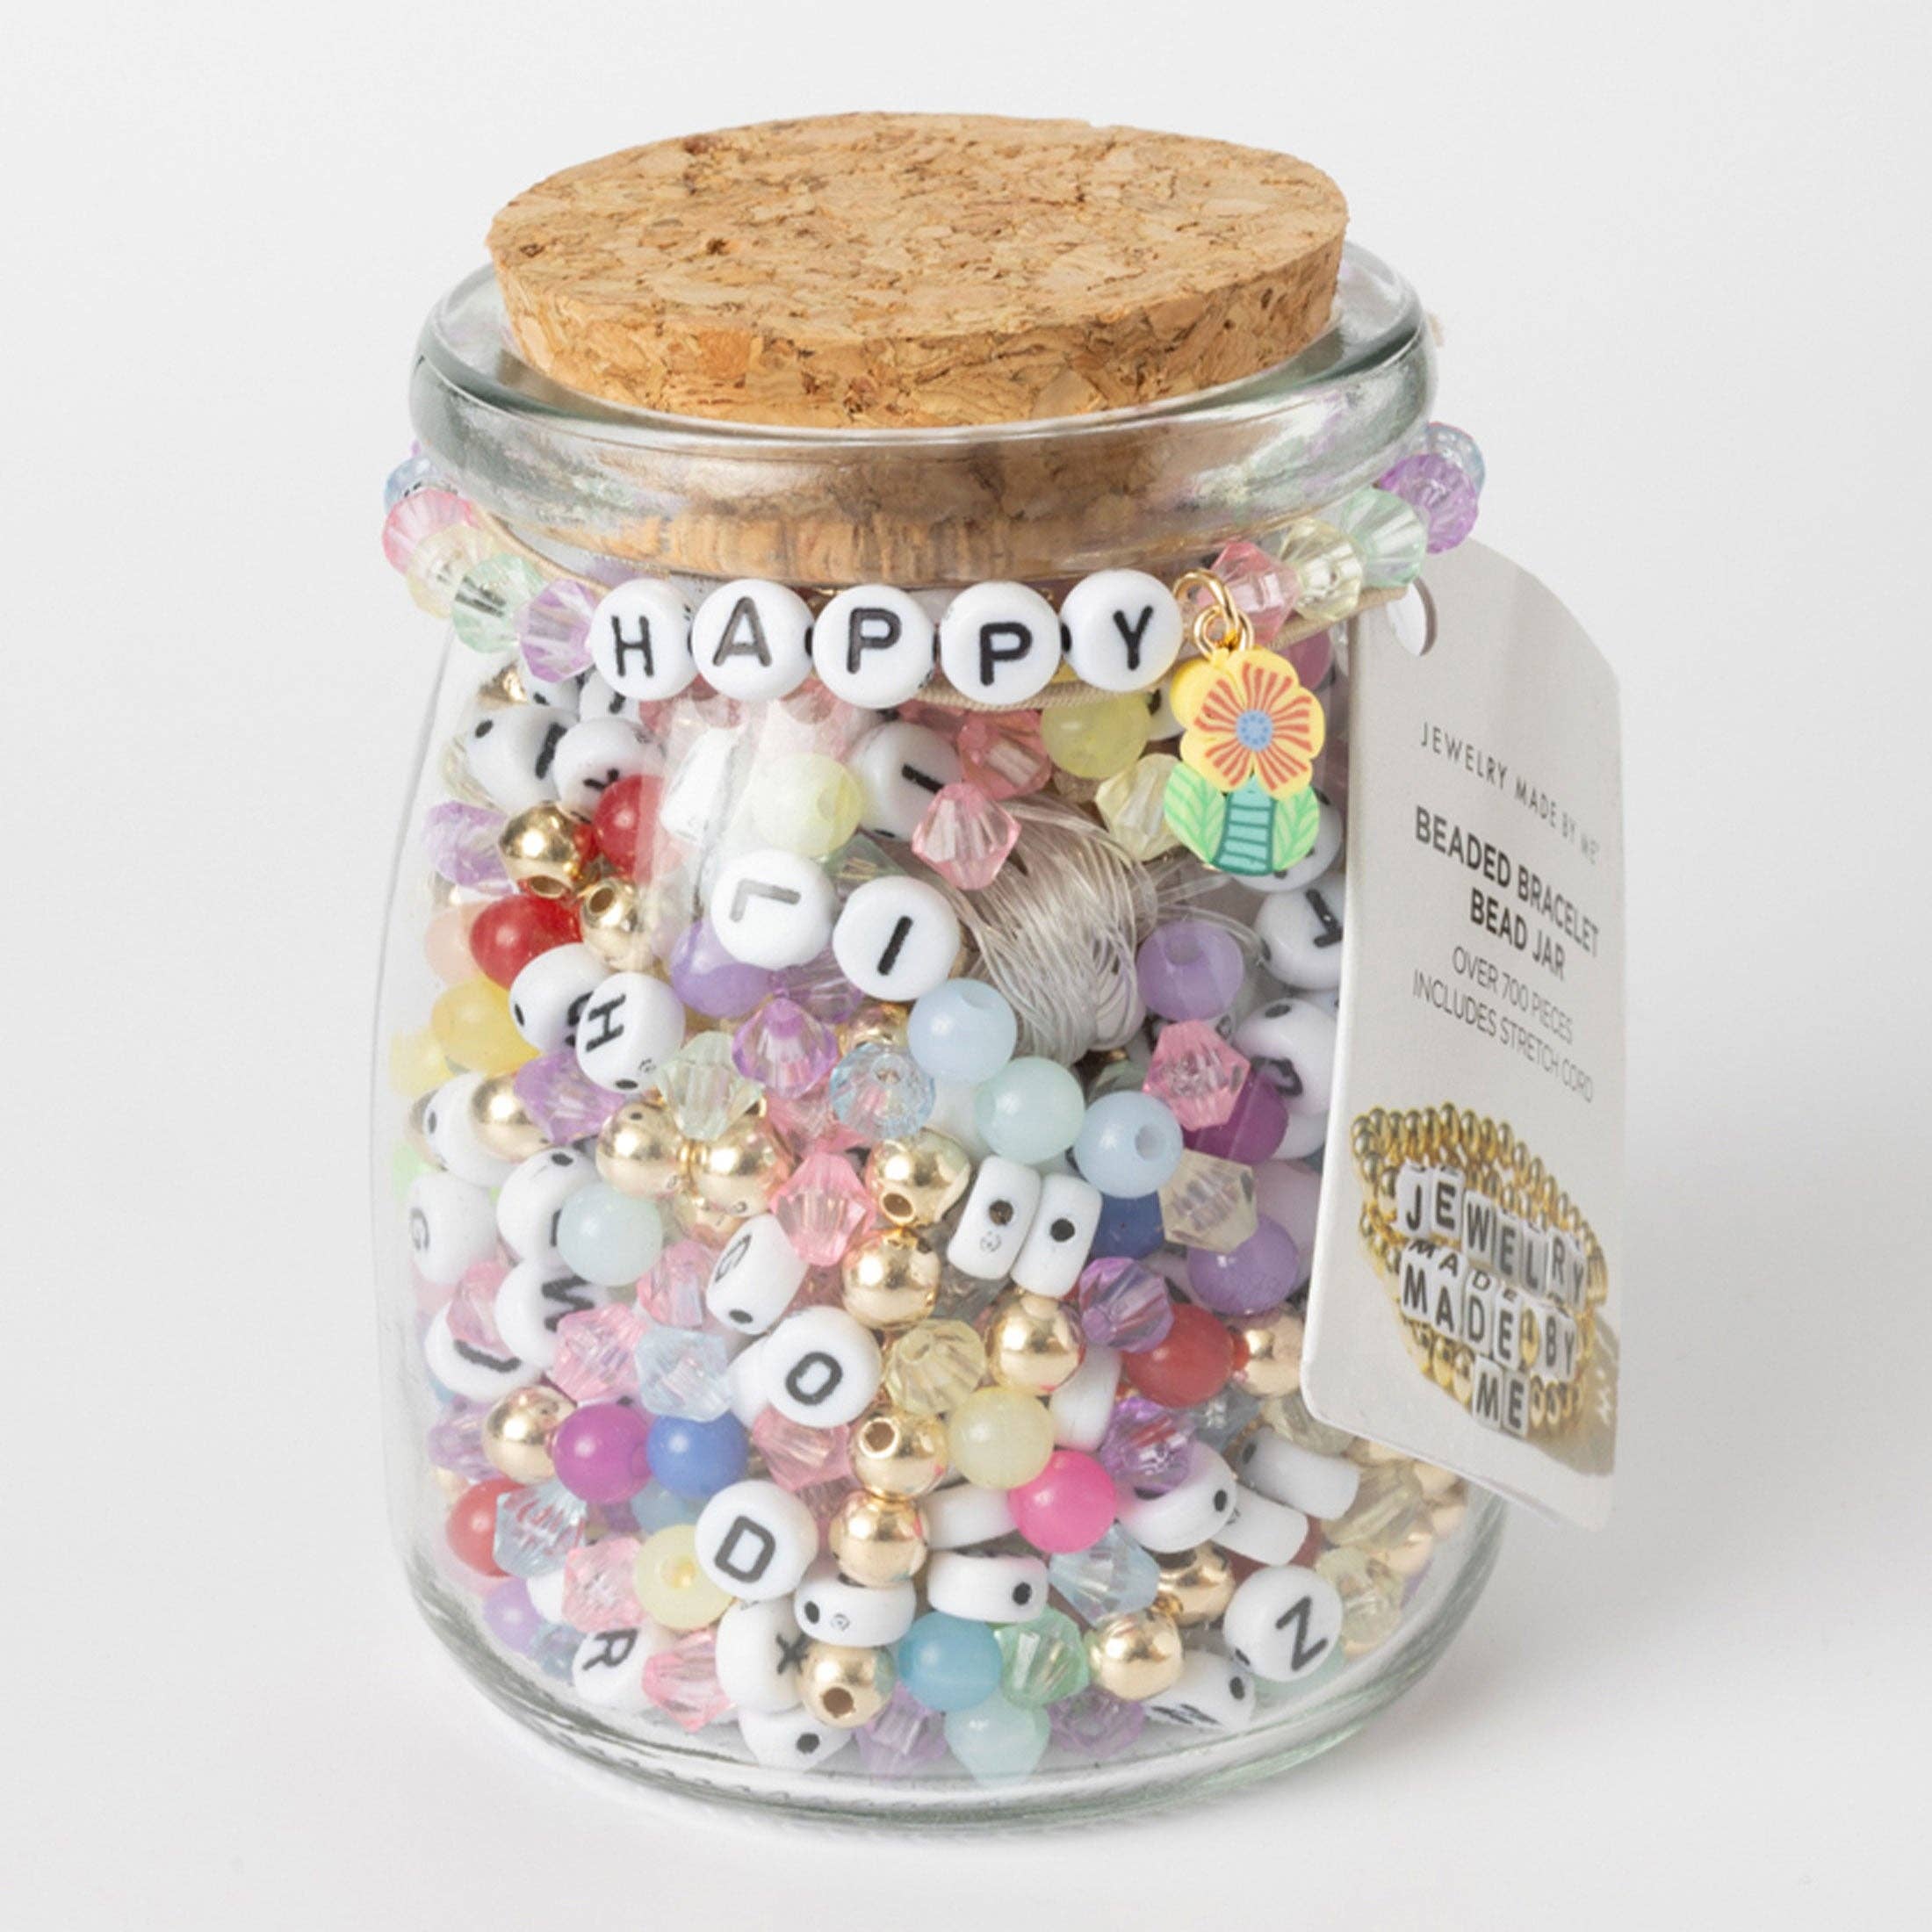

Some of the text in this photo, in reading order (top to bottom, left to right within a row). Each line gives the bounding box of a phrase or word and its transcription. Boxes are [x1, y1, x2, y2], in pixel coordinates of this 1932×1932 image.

[611, 595, 1154, 687] HAPPY
[1420, 721, 1508, 789] JEWELRY
[1515, 775, 1556, 828] MADE
[1416, 805, 1598, 957] BEADED BRACELET
[1470, 887, 1565, 981] BEAD JAR
[1413, 969, 1594, 1103] INCLUDES STRETCH CORD
[1453, 946, 1574, 1045] OVER 700 PIECES
[1406, 1181, 1583, 1305] JEWELRY
[1404, 1263, 1575, 1375] MADE BY
[1477, 1372, 1525, 1430] ME
[714, 1516, 776, 1583] D
